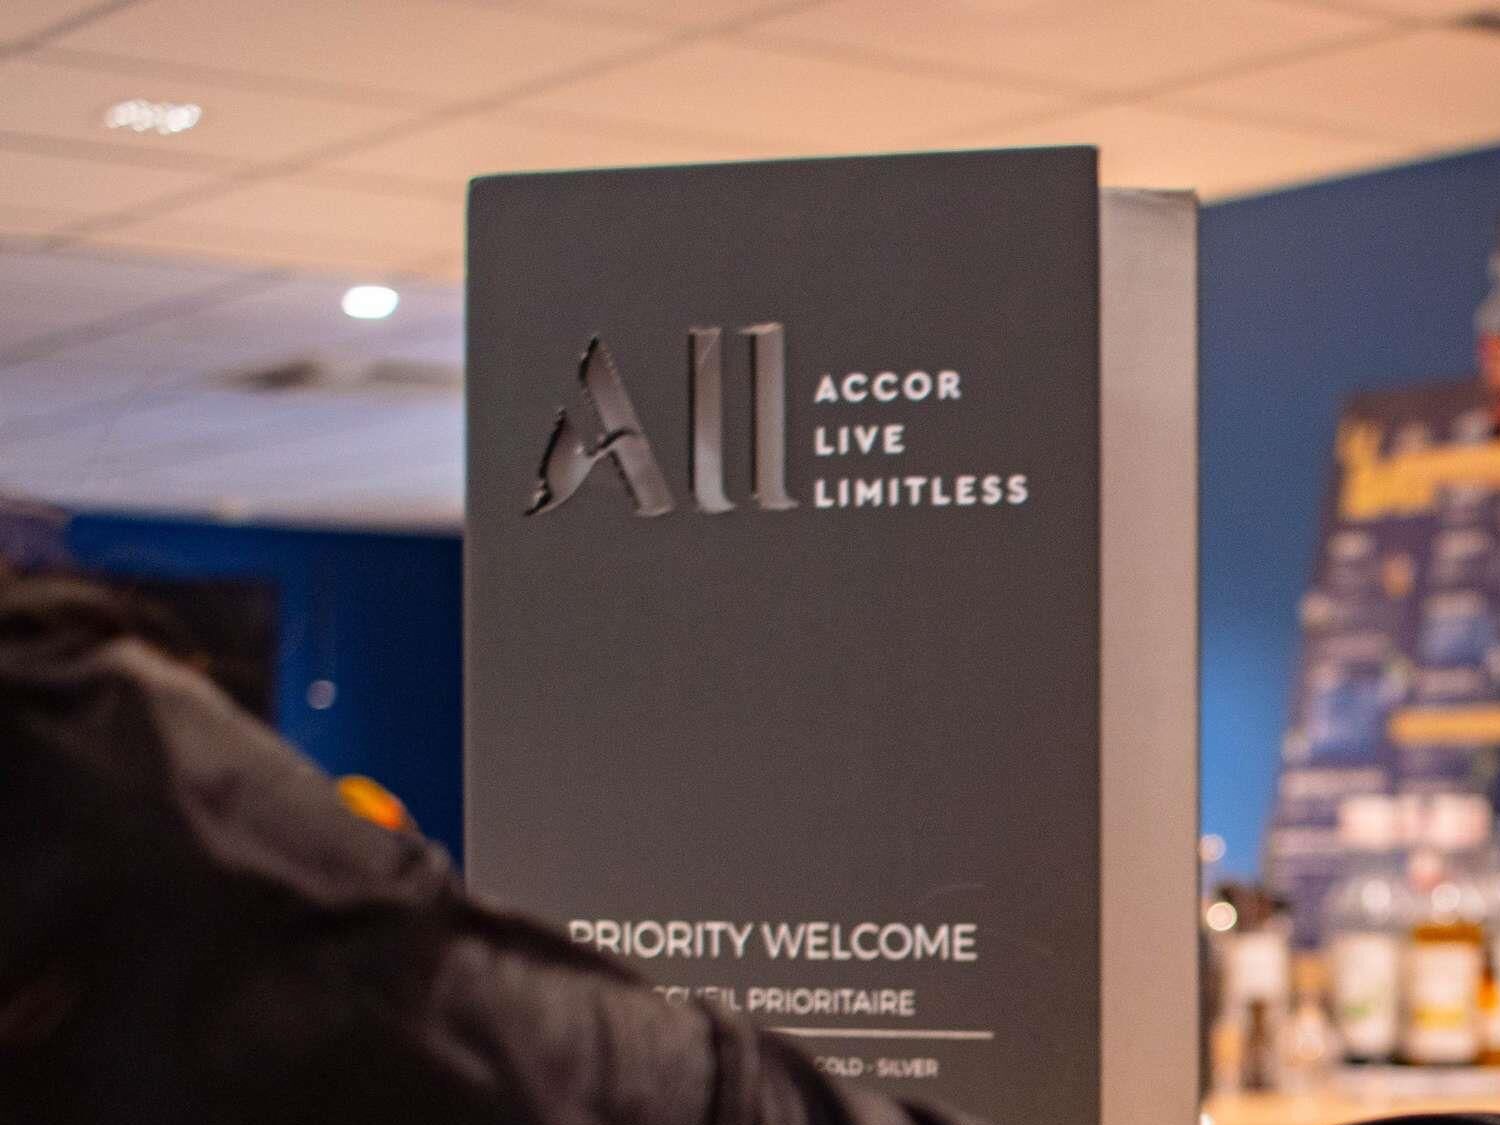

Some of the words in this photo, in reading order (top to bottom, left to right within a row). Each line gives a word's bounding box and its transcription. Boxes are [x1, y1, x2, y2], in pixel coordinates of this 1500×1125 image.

[814, 371, 962, 402] ACCOR
[814, 425, 906, 455] LIVE
[814, 475, 1030, 508] LIMITLESS
[568, 919, 753, 960] PRIORITY
[761, 921, 979, 962] WELCOME
[747, 986, 917, 1017] PRIORITAIRE
[815, 1055, 864, 1078] GOLD
[877, 1056, 939, 1079] SILVER
